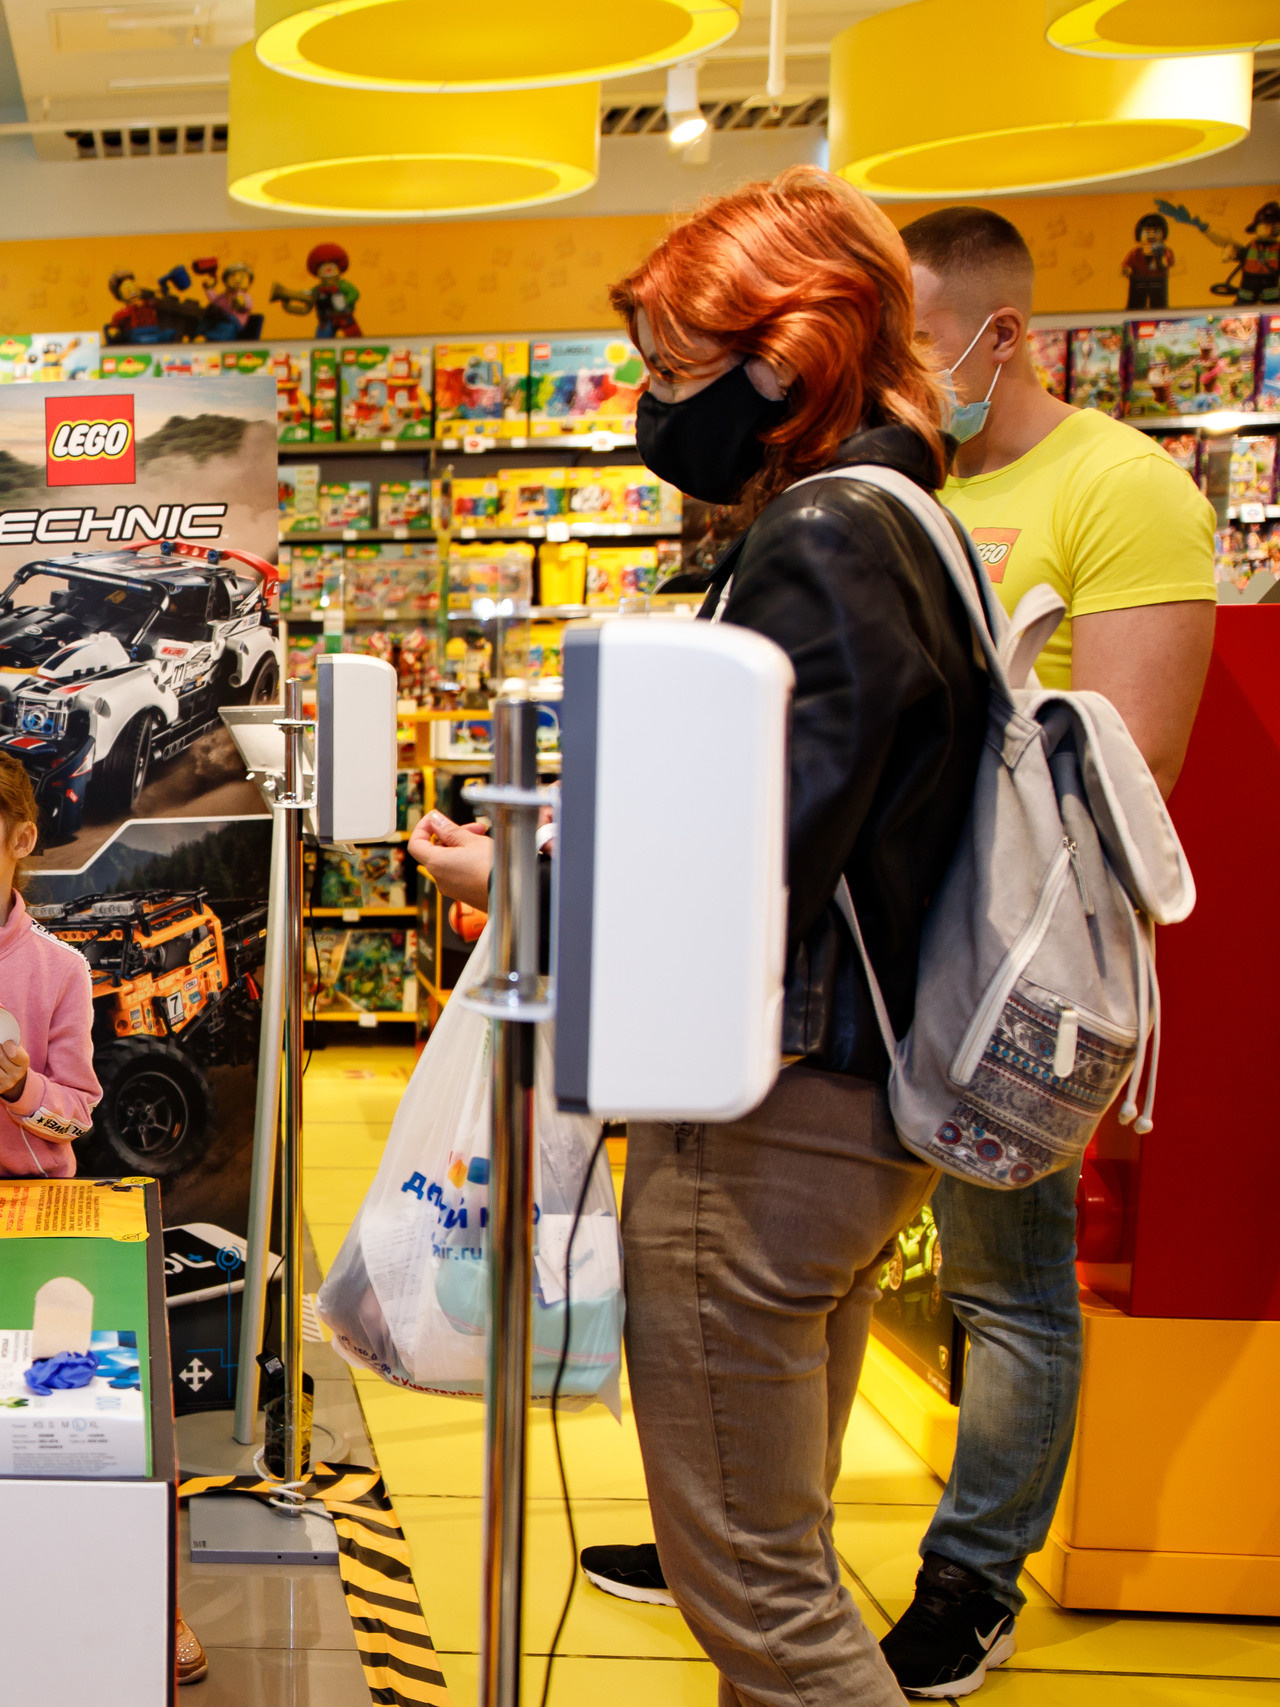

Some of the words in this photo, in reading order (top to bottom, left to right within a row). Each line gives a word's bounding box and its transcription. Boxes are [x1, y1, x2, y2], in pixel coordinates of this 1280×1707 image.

[53, 422, 129, 458] LEGO
[975, 543, 1009, 564] GO
[169, 994, 178, 1015] 7
